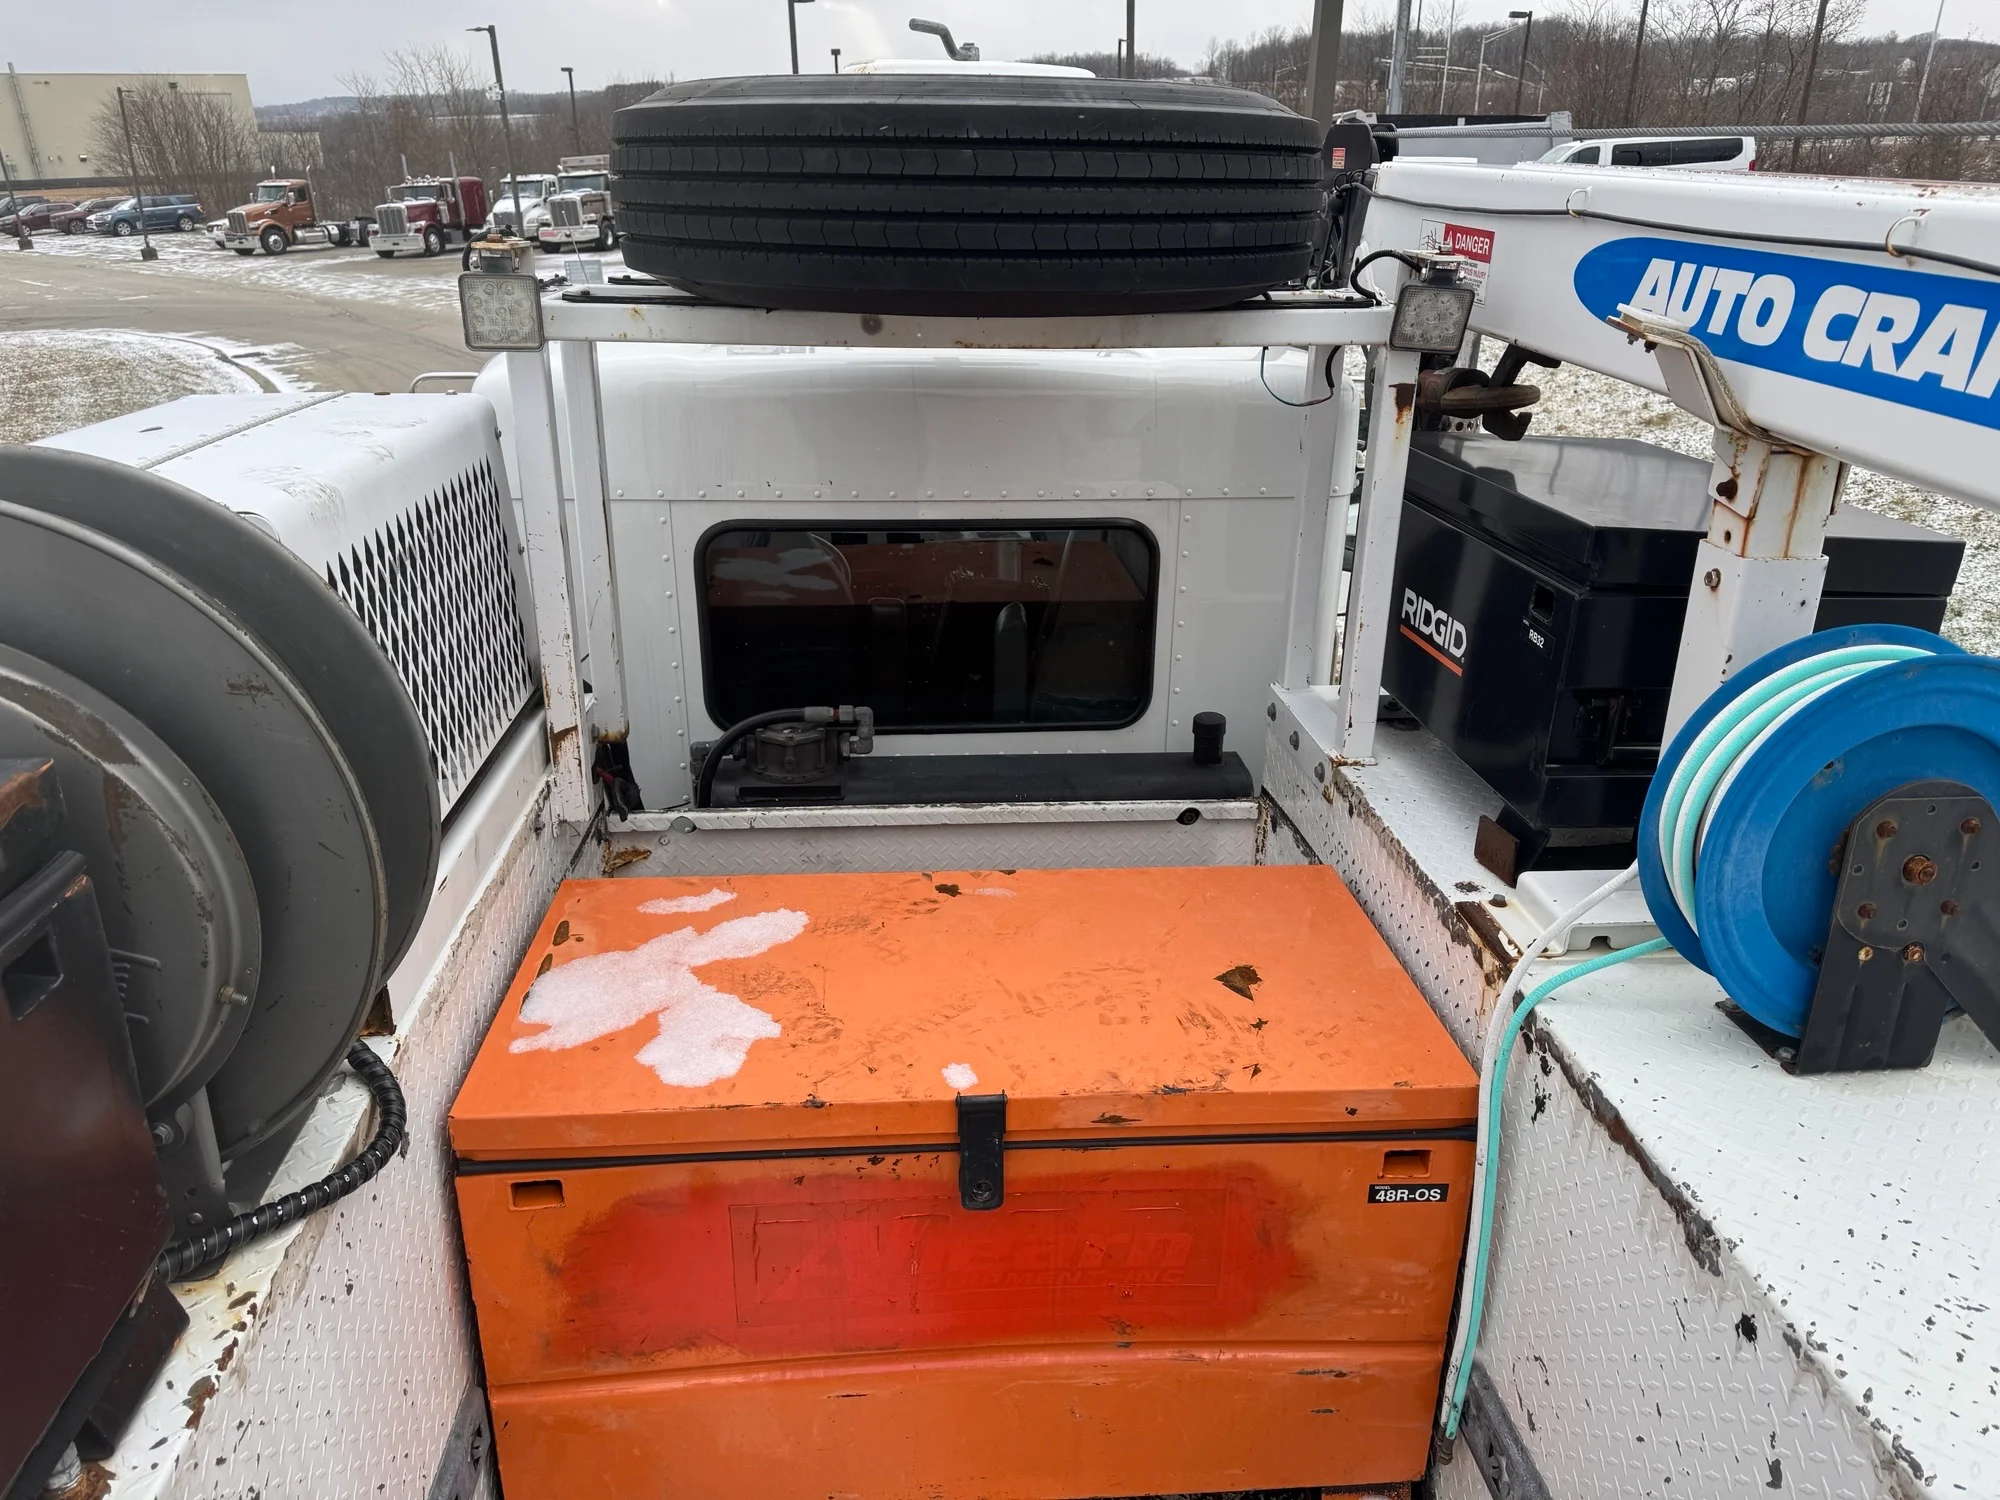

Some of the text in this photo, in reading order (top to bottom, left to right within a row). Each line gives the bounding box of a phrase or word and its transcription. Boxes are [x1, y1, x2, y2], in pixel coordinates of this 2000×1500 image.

[1455, 233, 1490, 255] DANGER
[1629, 257, 1795, 346] AUTO
[1401, 587, 1466, 659] RIDGID
[1528, 628, 1545, 649] RB32
[1375, 1189, 1441, 1202] 48R-OS
